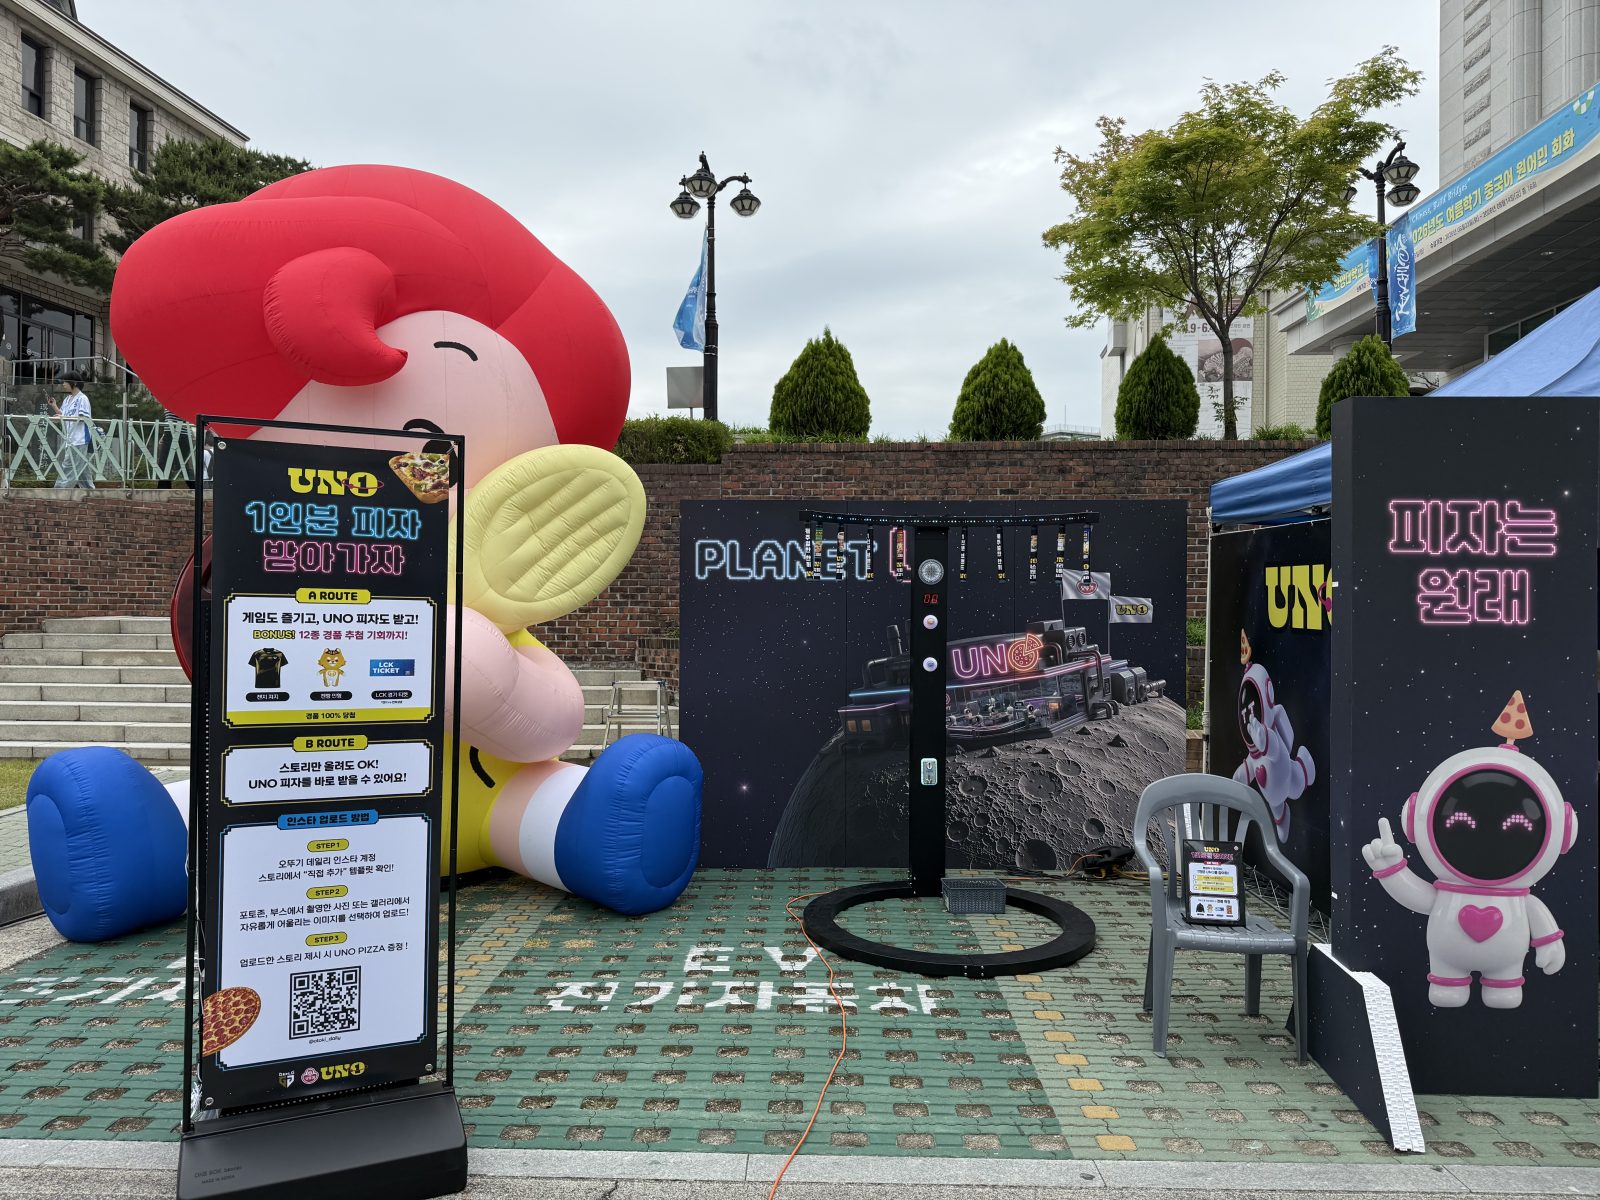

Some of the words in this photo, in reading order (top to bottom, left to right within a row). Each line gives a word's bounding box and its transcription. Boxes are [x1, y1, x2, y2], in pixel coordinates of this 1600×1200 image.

[1446, 190, 1482, 224] 여름학기
[1484, 167, 1514, 200] 중국어
[1516, 144, 1548, 180] 원어민
[1551, 128, 1574, 159] 회화
[246, 502, 338, 537] 1인분
[352, 506, 422, 540] 피자
[1388, 500, 1557, 555] 피자는
[263, 540, 405, 576] 받아가자
[695, 540, 877, 580] PLANET
[308, 591, 317, 600] A
[320, 591, 358, 600] ROUTE
[1265, 564, 1332, 630] UN
[1418, 568, 1529, 624] 원래
[242, 612, 278, 624] 게임도
[281, 612, 320, 626] 즐기고,
[322, 613, 354, 624] UNO
[356, 614, 391, 625] 피자도
[392, 614, 419, 626] 받고!
[253, 630, 296, 640] BONUS!
[298, 630, 320, 640] 12종
[322, 630, 342, 640] 경품
[345, 630, 364, 640] 추첨
[368, 630, 408, 640] 기회까지!
[306, 740, 313, 748] B
[316, 738, 354, 748] ROUTE
[279, 762, 322, 774] 스토리만
[324, 760, 354, 772] 올려도
[357, 760, 379, 769] OK!
[248, 779, 278, 789] UNO
[280, 777, 312, 788] 피자를
[314, 776, 335, 787] 바로
[338, 775, 358, 786] 받을
[360, 774, 371, 784] 수
[373, 773, 407, 784] 있어요!
[286, 815, 316, 826] 인스타
[319, 814, 348, 825] 업로드
[351, 812, 370, 823] 방법
[278, 860, 303, 869] 오뚜기
[306, 857, 330, 867] 데일리
[333, 856, 358, 865] 인스타
[360, 853, 376, 862] 계정
[258, 871, 301, 882] 스토리에서
[349, 865, 373, 875] 템플릿
[375, 864, 394, 873] 확인!
[239, 910, 268, 920] 포토존,
[270, 906, 304, 917] 부스에서
[306, 904, 331, 914] 촬영한
[333, 902, 350, 911] 사진
[352, 900, 368, 910] 또는
[370, 897, 410, 908] 갤러리에서
[239, 921, 275, 932] 자유롭게
[277, 917, 311, 928] 어울리는
[313, 914, 346, 925] 이미지를
[348, 910, 381, 922] 선택하여
[382, 908, 409, 918] 업로드!
[314, 936, 334, 944] STEP
[239, 956, 274, 968] 업로드한
[276, 953, 302, 964] 스토리
[304, 951, 321, 961] 제시
[323, 950, 332, 959] 시
[334, 947, 356, 958] UNO
[358, 945, 386, 955] PIZZA
[388, 943, 403, 952] 증정
[546, 982, 942, 1014] 전기자동차
